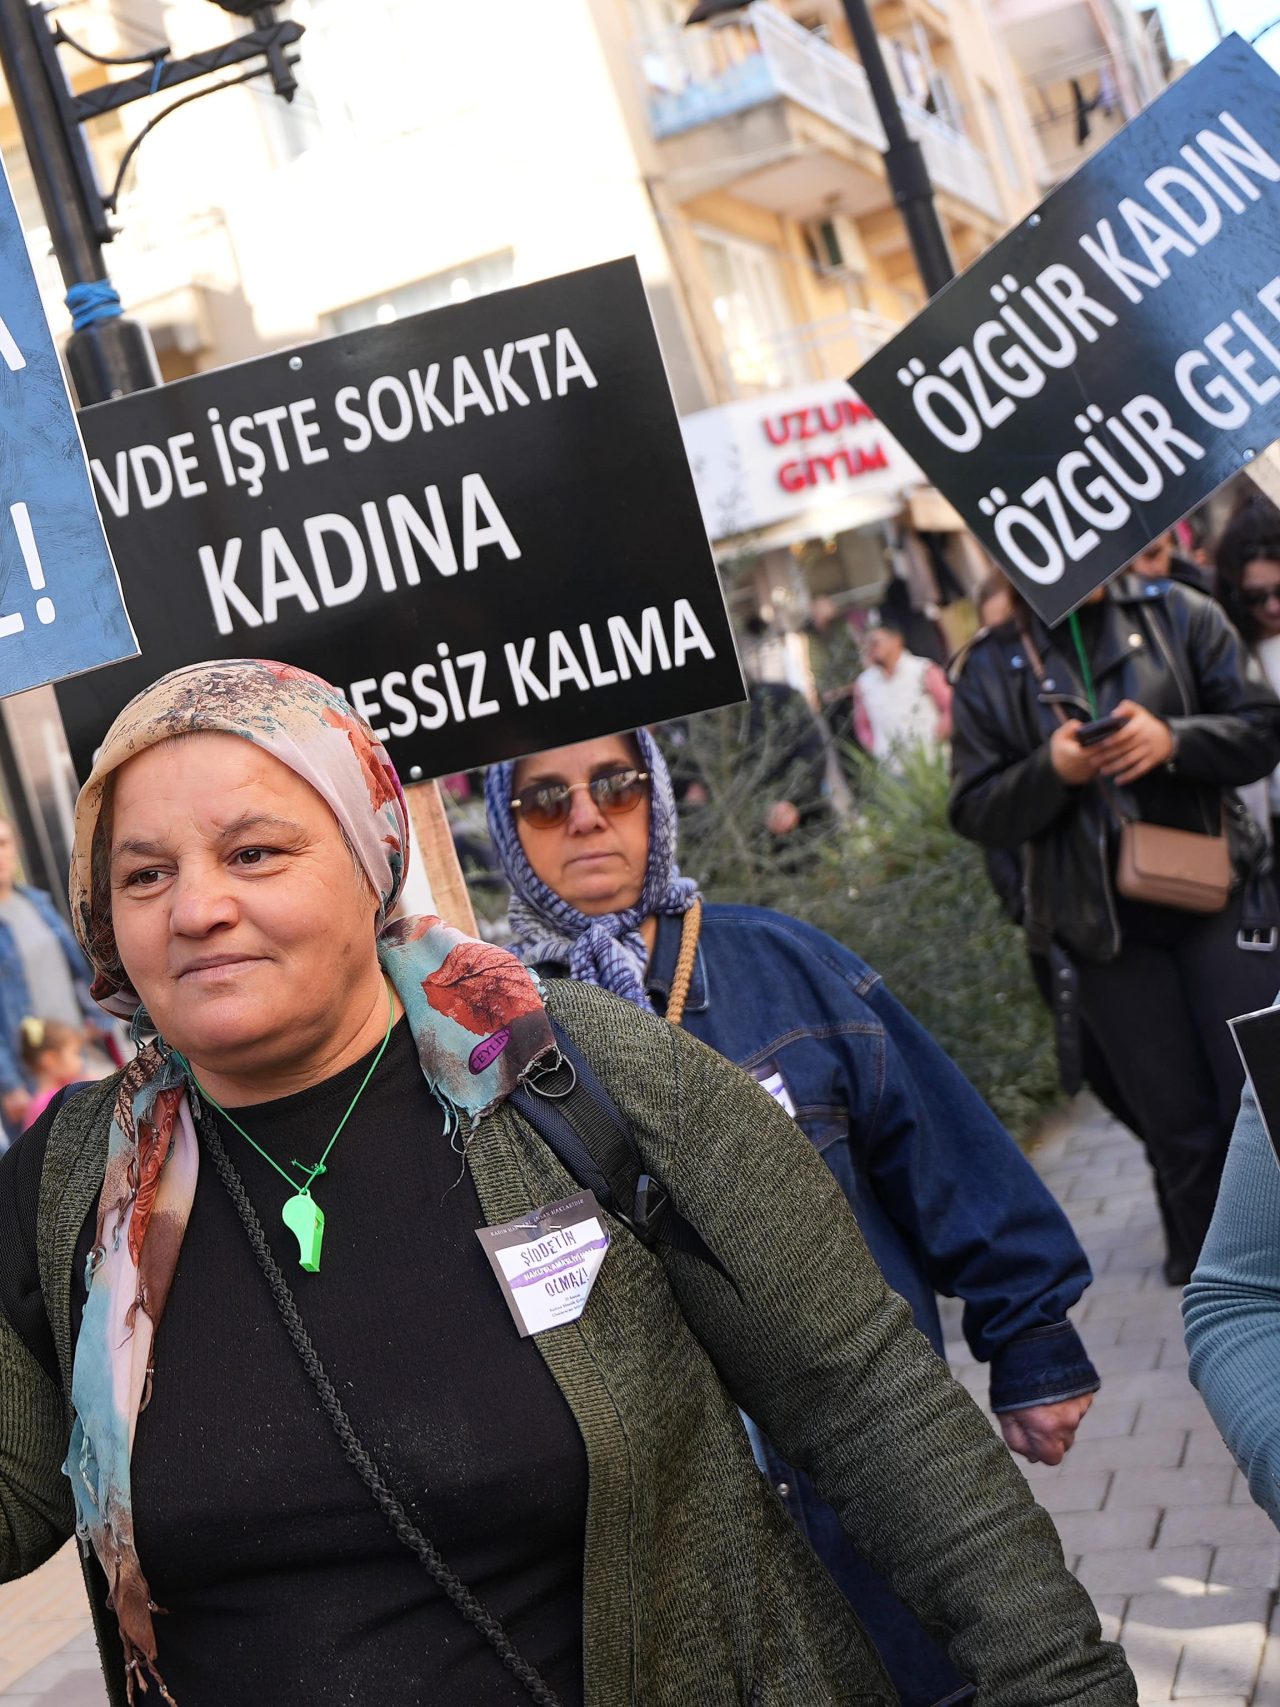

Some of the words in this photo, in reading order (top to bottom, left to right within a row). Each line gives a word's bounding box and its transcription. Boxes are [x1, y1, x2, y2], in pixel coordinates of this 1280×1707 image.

[897, 264, 1117, 453] ÖZGÜR
[1078, 111, 1280, 304] KADIN
[89, 431, 208, 518] VDE
[207, 397, 330, 497] İŞTE
[334, 327, 598, 453] SOKAKTA
[978, 395, 1205, 584] ÖZGÜR
[198, 473, 521, 635] KADINA
[334, 642, 500, 743] ESSİZ
[503, 598, 715, 706] KALMA
